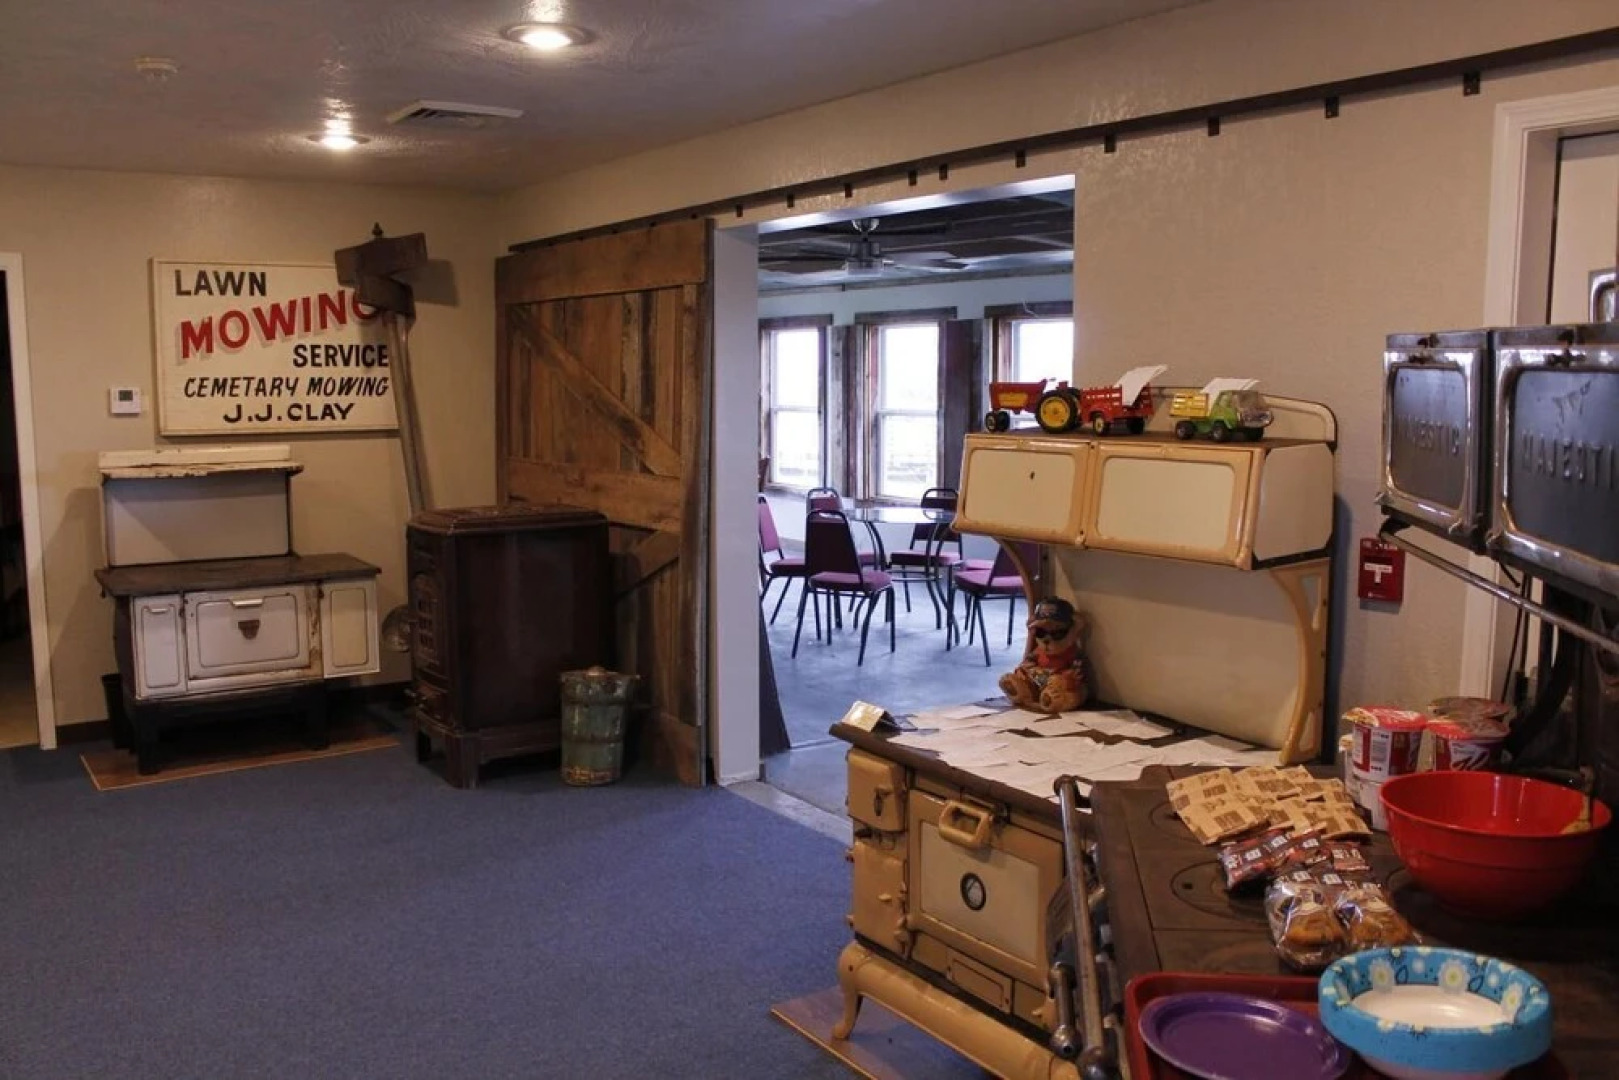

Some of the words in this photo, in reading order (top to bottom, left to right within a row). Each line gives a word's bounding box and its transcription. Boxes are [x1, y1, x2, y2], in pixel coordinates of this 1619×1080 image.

[174, 269, 267, 297] LAWN
[293, 344, 389, 368] SERVICE
[184, 376, 298, 398] CEMETARY
[306, 376, 389, 397] MOWING
